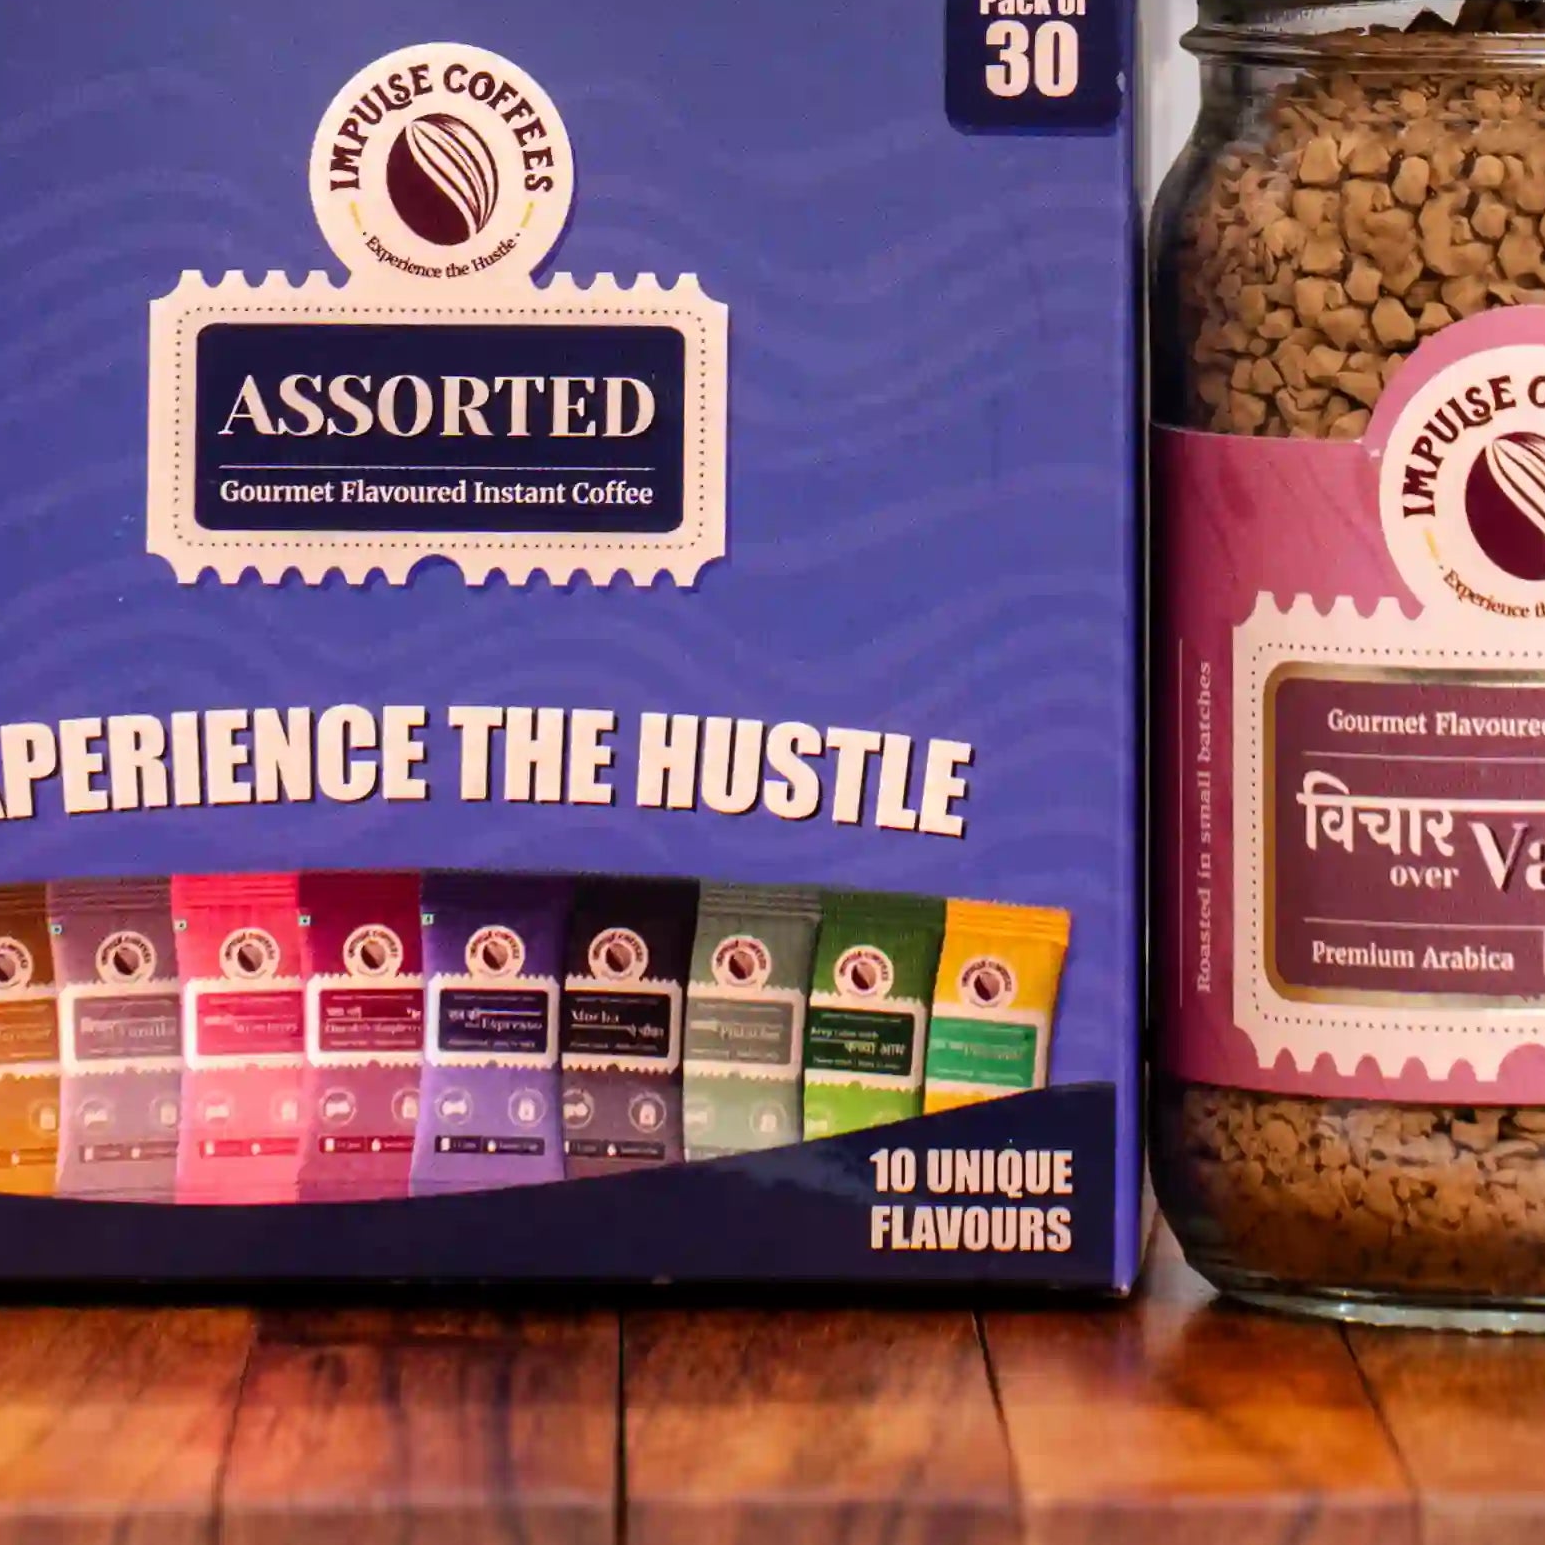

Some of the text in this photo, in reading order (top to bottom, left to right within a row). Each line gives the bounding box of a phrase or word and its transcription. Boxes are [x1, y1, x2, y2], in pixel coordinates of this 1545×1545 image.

[985, 20, 1079, 98] 30
[330, 63, 554, 193] IMPULSE COFFEES
[364, 235, 518, 278] Experience the Hustle
[217, 373, 656, 437] ASSORTED
[1402, 374, 1517, 519] IMPULSE
[219, 480, 654, 504] Gourmet Flavoured Instant Coffee
[1442, 568, 1530, 618] Experience
[1327, 708, 1428, 736] Gourmet
[449, 705, 617, 804] THE
[636, 711, 974, 837] HUSTLE
[1196, 662, 1212, 994] Roasted in small batches
[1296, 770, 1455, 856] विचार
[1390, 863, 1459, 889] over
[1311, 939, 1515, 972] Premium Arabica
[869, 1147, 1073, 1198] 10 UNIQUE
[870, 1205, 1072, 1252] FLAVOURS
